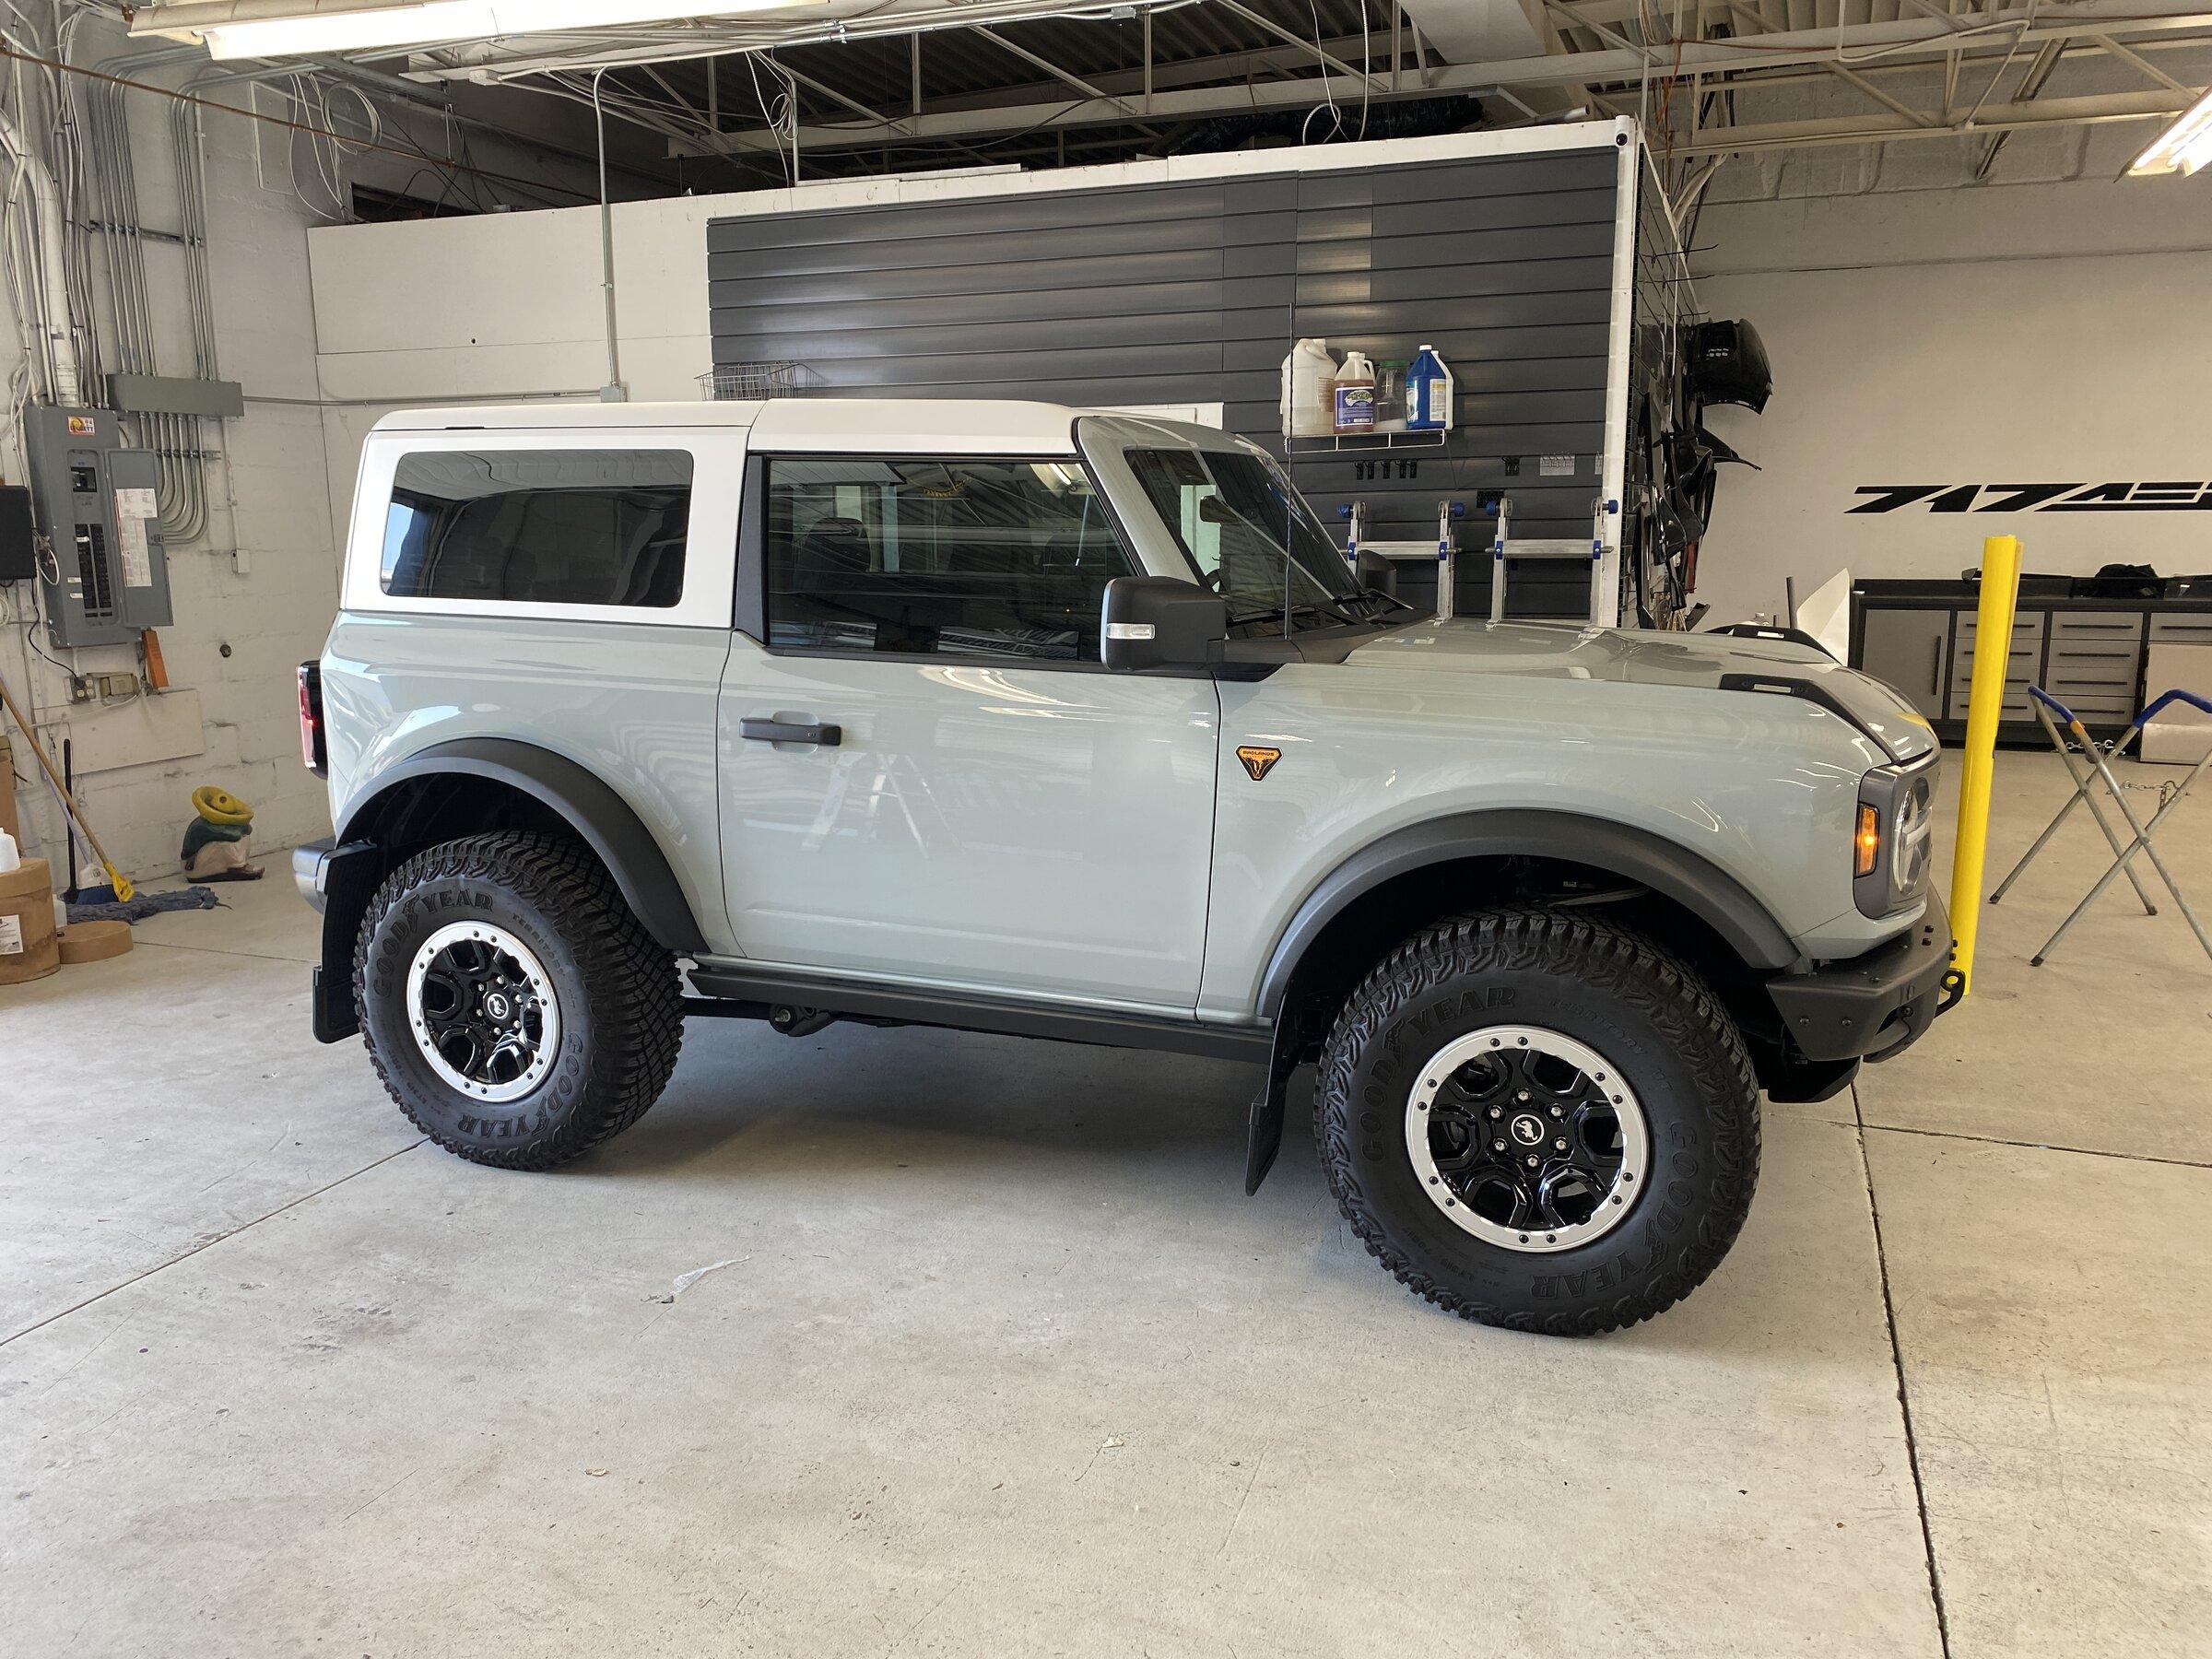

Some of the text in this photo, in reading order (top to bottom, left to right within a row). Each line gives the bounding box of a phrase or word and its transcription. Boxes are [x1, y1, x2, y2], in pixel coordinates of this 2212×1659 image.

[1843, 481, 2212, 513] 717AE
[373, 889, 494, 997] GOODYEAR
[458, 1033, 582, 1138] GOODYEAR
[1359, 986, 1516, 1161] GOODYEAR
[1530, 1121, 1698, 1300] GOODYEAR
